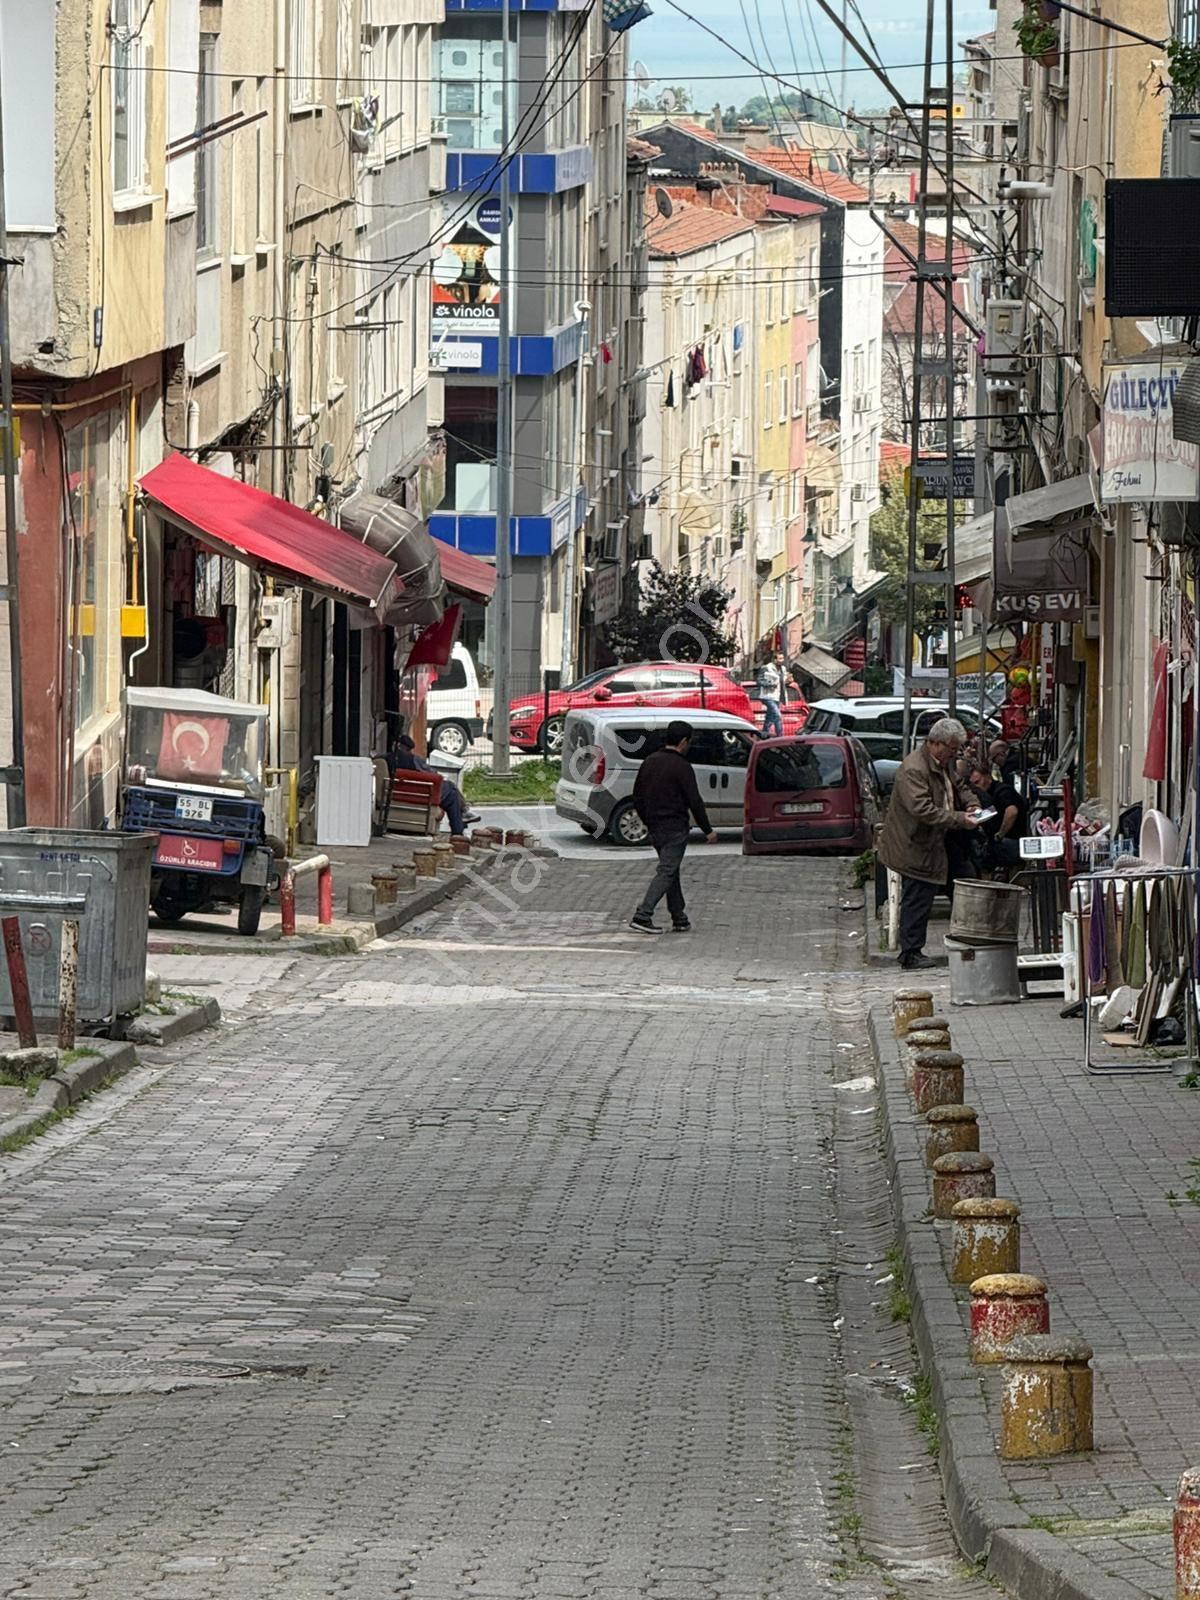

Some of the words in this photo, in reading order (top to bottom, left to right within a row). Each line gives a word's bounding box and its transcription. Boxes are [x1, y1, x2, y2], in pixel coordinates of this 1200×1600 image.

[452, 304, 495, 318] vinola
[448, 350, 480, 359] vinola
[1110, 368, 1181, 417] GÜLEÇYÜ
[1111, 471, 1142, 490] Fehmi
[996, 594, 1041, 613] KUŞ
[1045, 589, 1081, 609] EVİ
[180, 798, 192, 808] 55
[184, 808, 203, 818] 976
